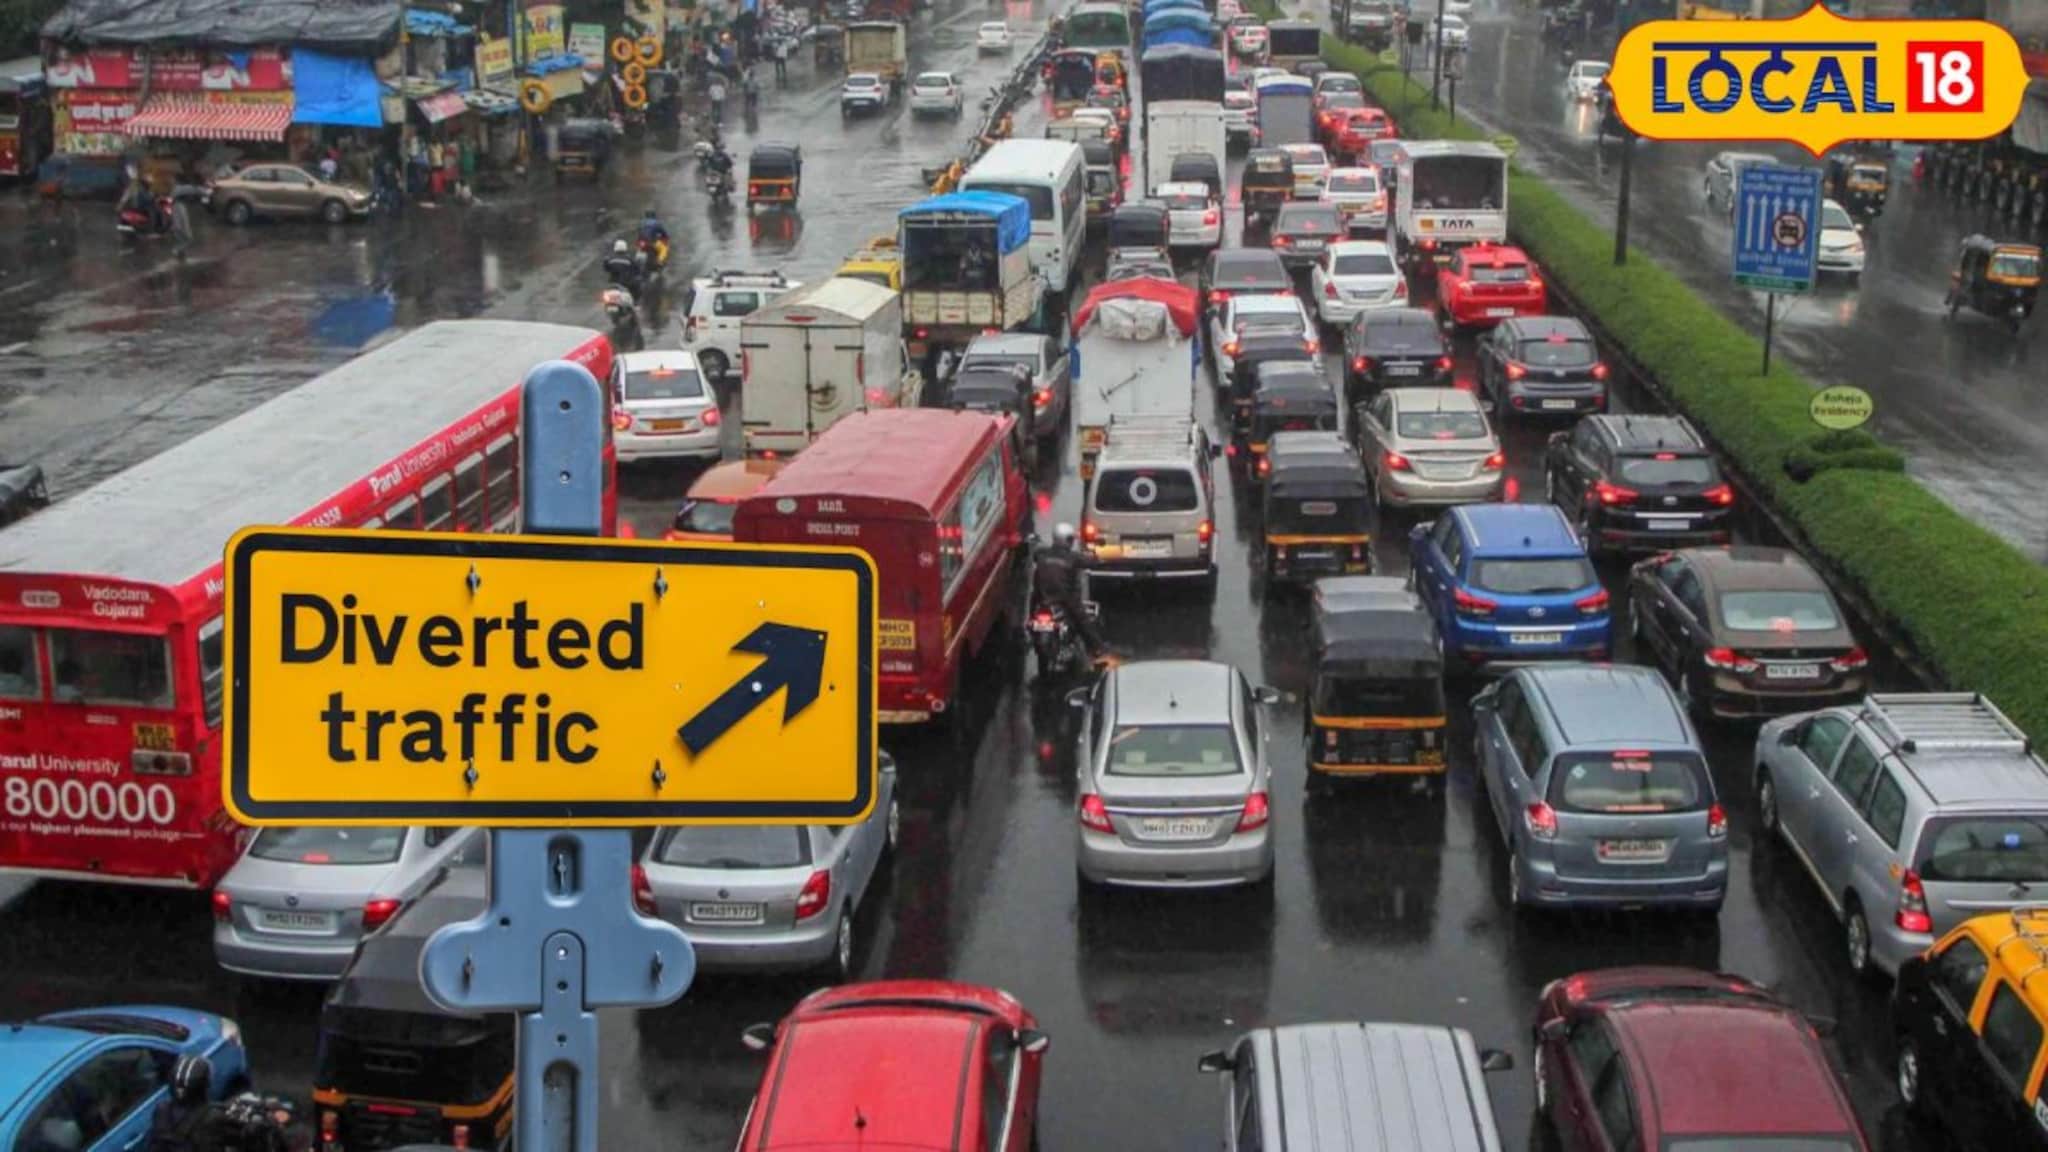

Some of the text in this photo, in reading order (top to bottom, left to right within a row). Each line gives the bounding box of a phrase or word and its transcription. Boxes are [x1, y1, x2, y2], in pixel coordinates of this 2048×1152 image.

[1441, 219, 1474, 229] TATA
[367, 462, 403, 497] Parul
[400, 439, 448, 478] University
[817, 499, 847, 513] MAIL
[834, 523, 860, 537] POST
[92, 601, 146, 620] Gujarat
[280, 592, 644, 671] Diverted
[320, 691, 600, 764] traffic
[0, 753, 121, 778] arul University
[4, 776, 176, 825] 800000
[30, 821, 72, 835] highest
[133, 826, 181, 843] package
